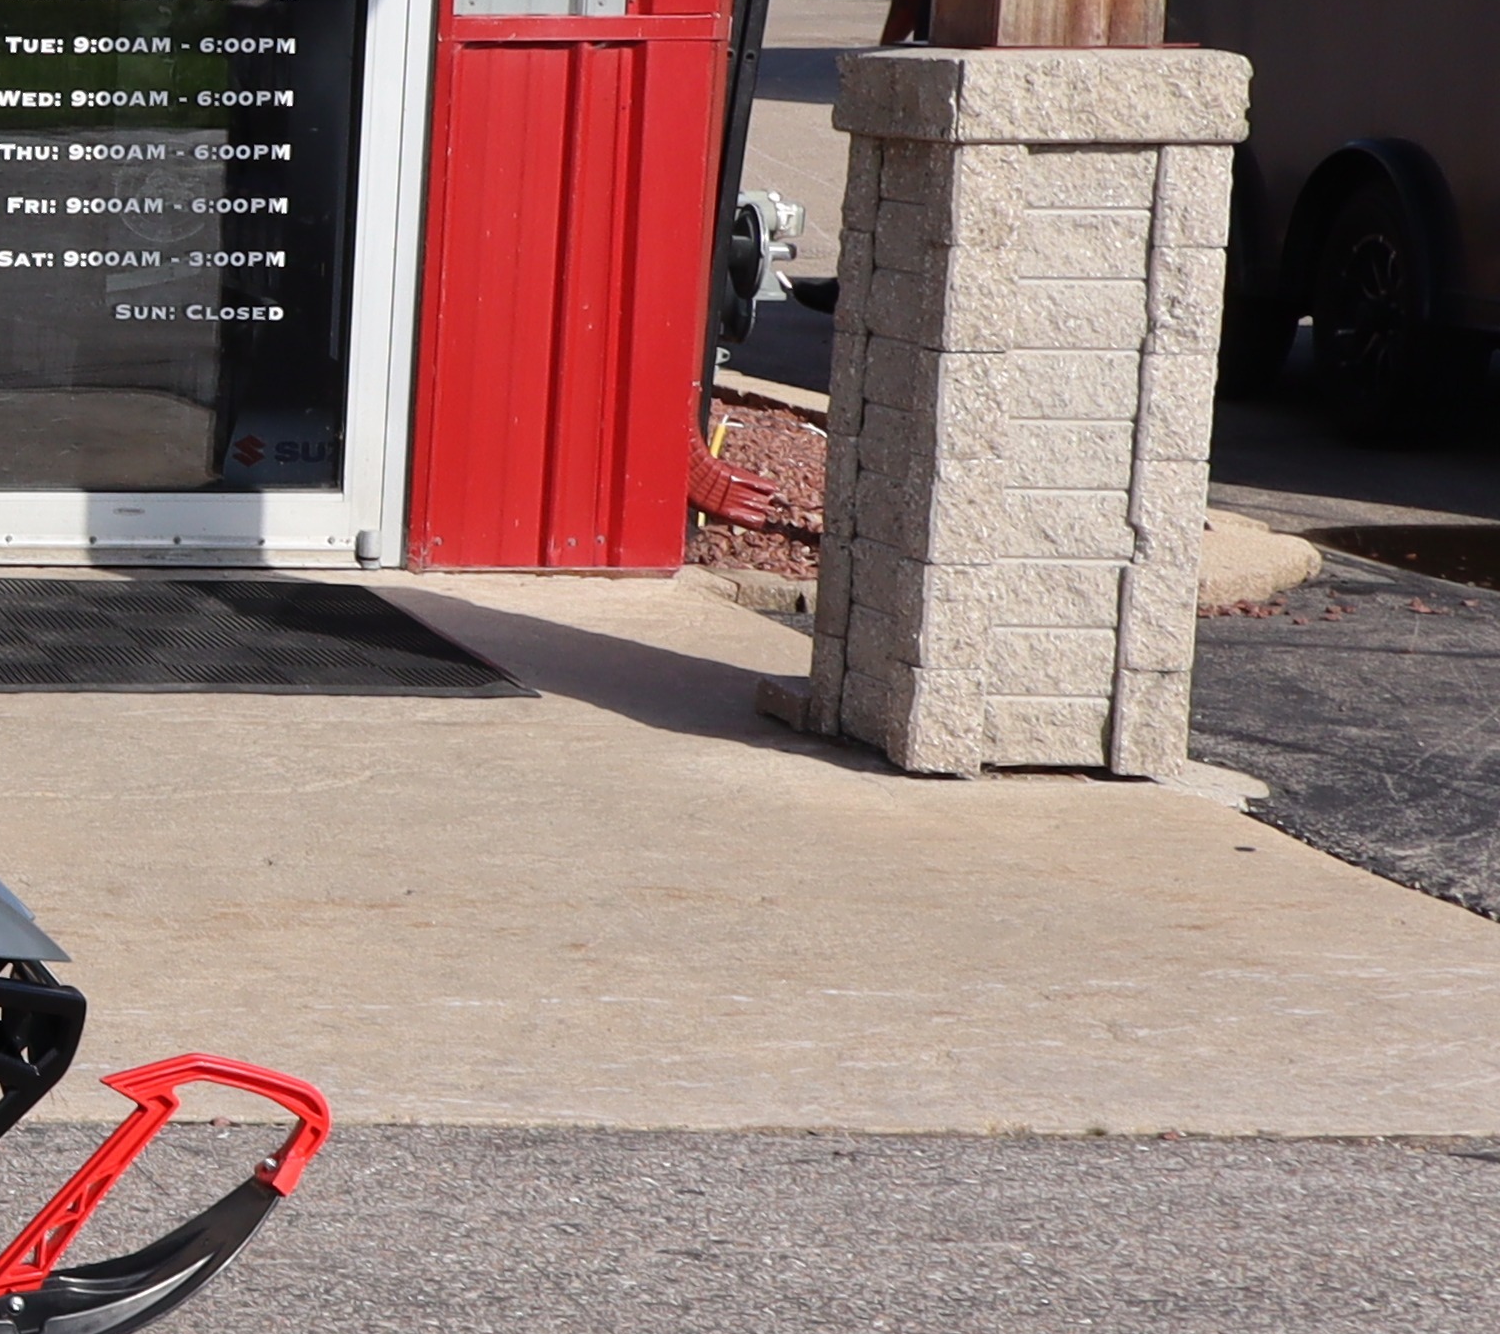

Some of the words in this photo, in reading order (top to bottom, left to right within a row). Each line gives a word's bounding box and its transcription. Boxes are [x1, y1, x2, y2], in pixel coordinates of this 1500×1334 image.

[5, 36, 64, 54] TUE:
[73, 36, 171, 54] 9:00AM
[199, 37, 296, 54] 6:00PM
[70, 89, 169, 107] 9:00AM
[197, 90, 294, 107] 6:00PM
[0, 143, 59, 160] THU:
[68, 143, 166, 161] 9:00AM
[194, 144, 291, 161] 6:00PM
[7, 196, 57, 214] FRI:
[65, 196, 164, 215] 9:00AM
[191, 197, 288, 215] 6:00PM
[63, 250, 161, 268] 9:00AM
[188, 250, 285, 268] 3:00PM
[115, 304, 176, 320] SUN:
[186, 304, 284, 321] CLOSED
